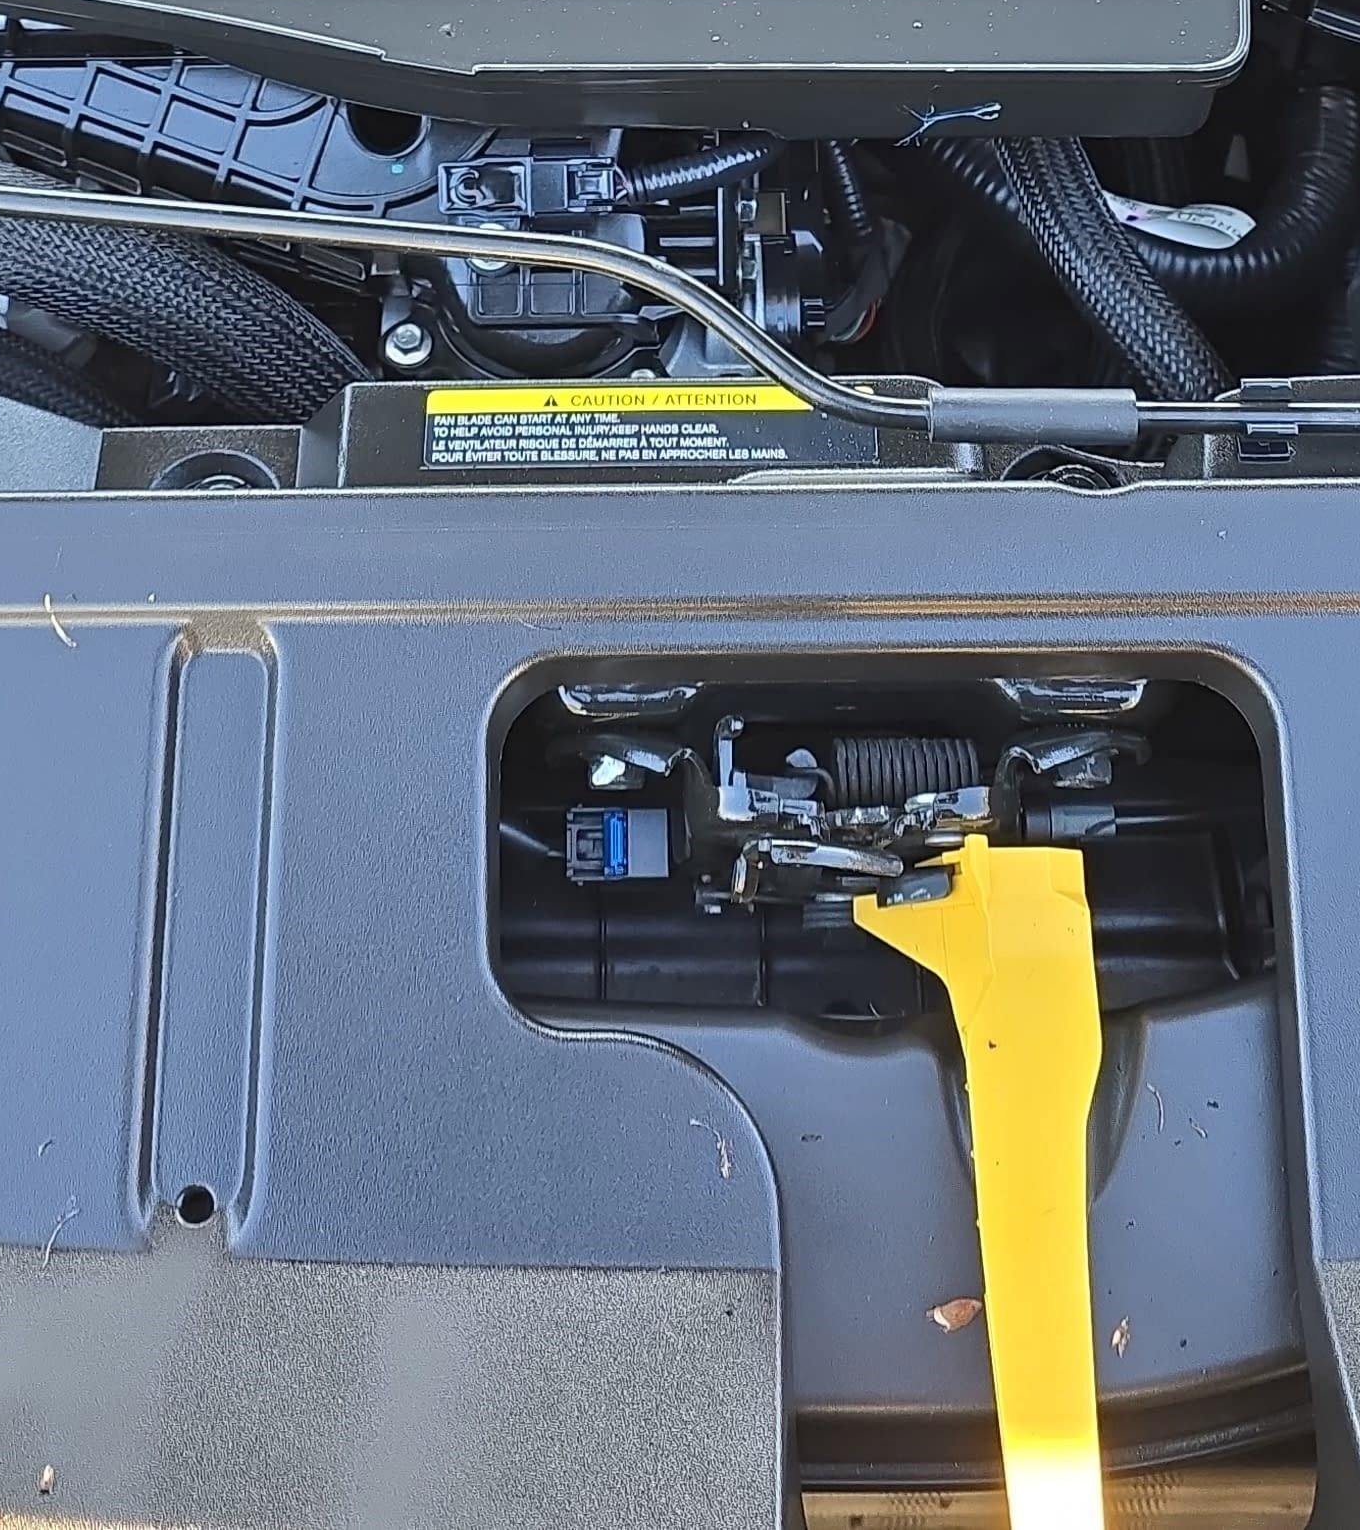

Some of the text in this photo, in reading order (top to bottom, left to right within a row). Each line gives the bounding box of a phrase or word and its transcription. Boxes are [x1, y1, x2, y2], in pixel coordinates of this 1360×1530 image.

[570, 392, 757, 407] CAUTION / ATTENTION
[433, 413, 621, 426] FAN BLADE CAN START AT ANY TIME.
[433, 427, 448, 438] TO
[450, 427, 478, 438] HELP
[479, 426, 513, 437] AVOID
[515, 425, 572, 436] PERSONAL
[640, 423, 678, 435] HANDS
[681, 423, 719, 435] CLEAR.
[432, 435, 730, 451] LE VENTILATEUR RISQUE DE DÉMARRER À TOUT MOMENT.
[431, 448, 789, 463] POUR ÉVITER TOUTE BLESSURE, NE PAS EN APPROCHER LES MAINS.
